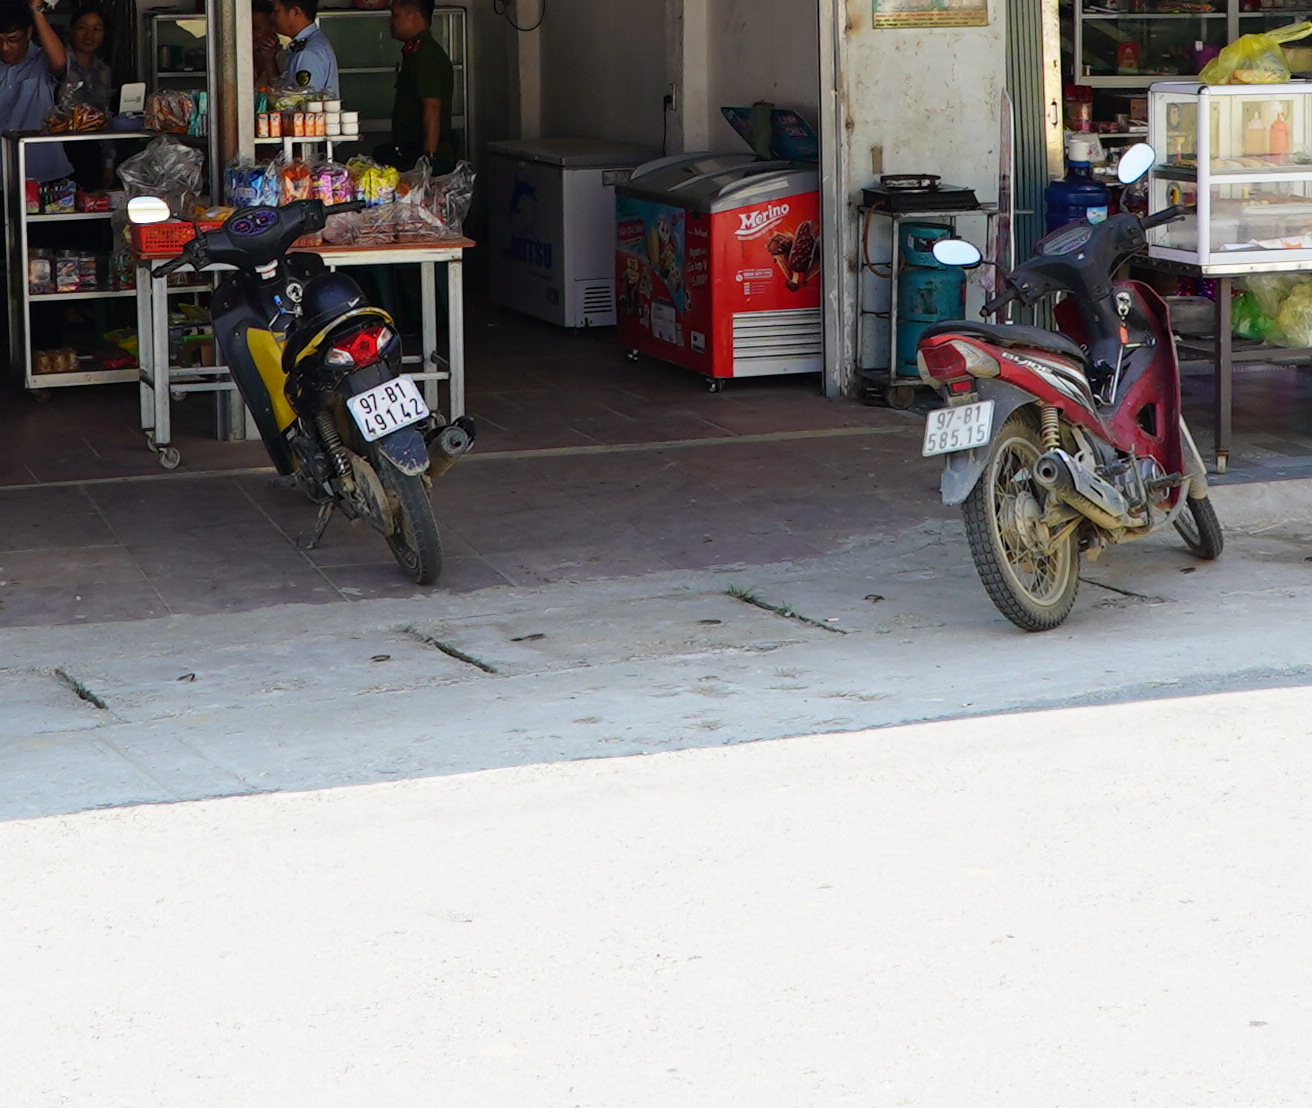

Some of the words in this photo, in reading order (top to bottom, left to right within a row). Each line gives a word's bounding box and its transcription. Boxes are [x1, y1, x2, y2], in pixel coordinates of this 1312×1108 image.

[737, 203, 790, 230] Merino
[360, 382, 407, 414] 97-B1
[365, 398, 424, 435] 491.42
[936, 405, 982, 431] 97-B1
[927, 424, 986, 452] 585.15
